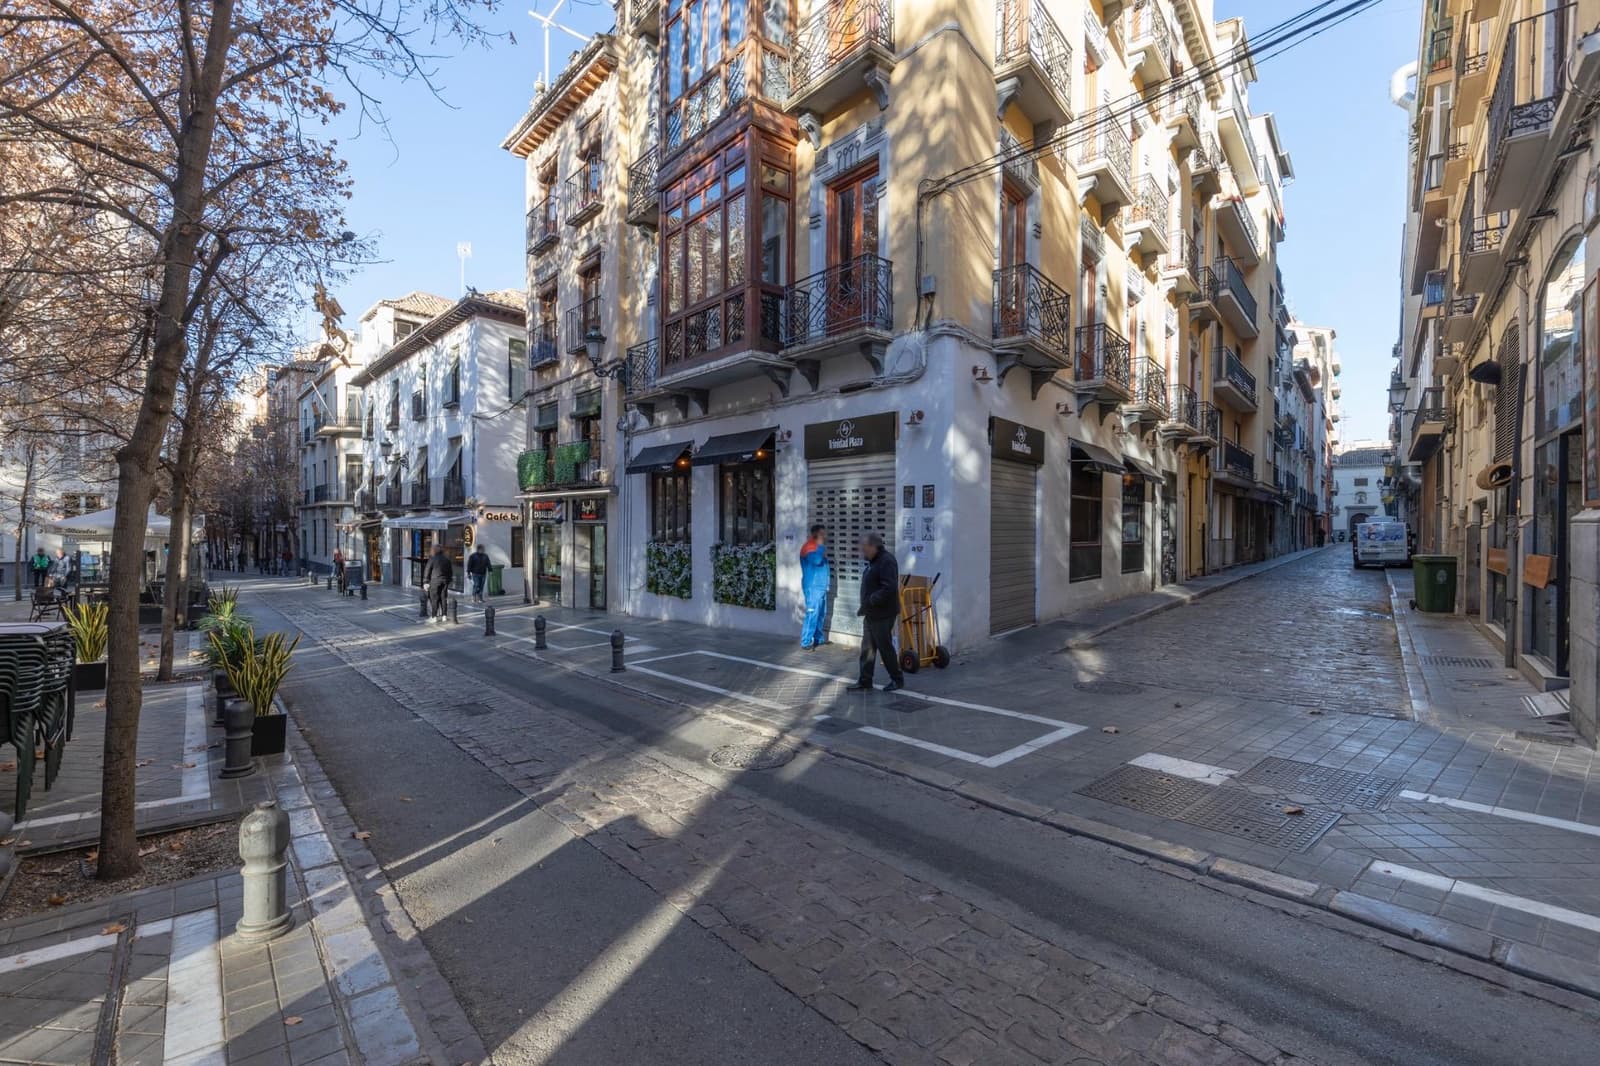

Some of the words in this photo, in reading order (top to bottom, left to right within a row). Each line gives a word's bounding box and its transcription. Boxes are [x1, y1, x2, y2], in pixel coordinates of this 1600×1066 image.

[829, 437, 848, 449] Trinidad
[849, 436, 863, 447] Plaza
[486, 512, 508, 521] Café
